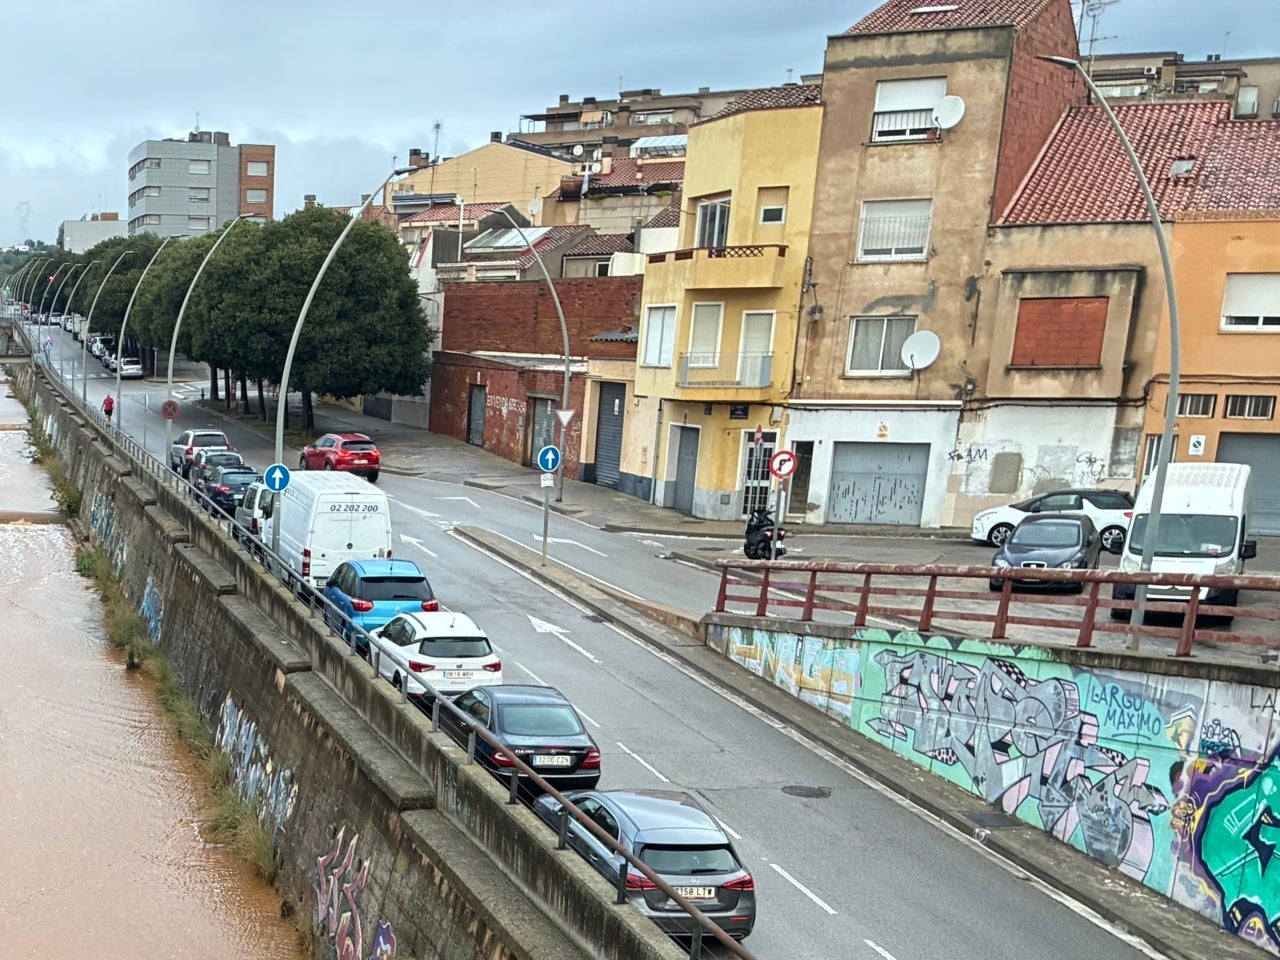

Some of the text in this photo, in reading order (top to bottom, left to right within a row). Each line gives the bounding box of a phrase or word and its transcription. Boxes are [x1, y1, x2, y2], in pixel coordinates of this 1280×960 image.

[330, 504, 379, 513] 02 202 200
[1091, 684, 1143, 713] LARGO
[1104, 708, 1162, 736] MAXIMO
